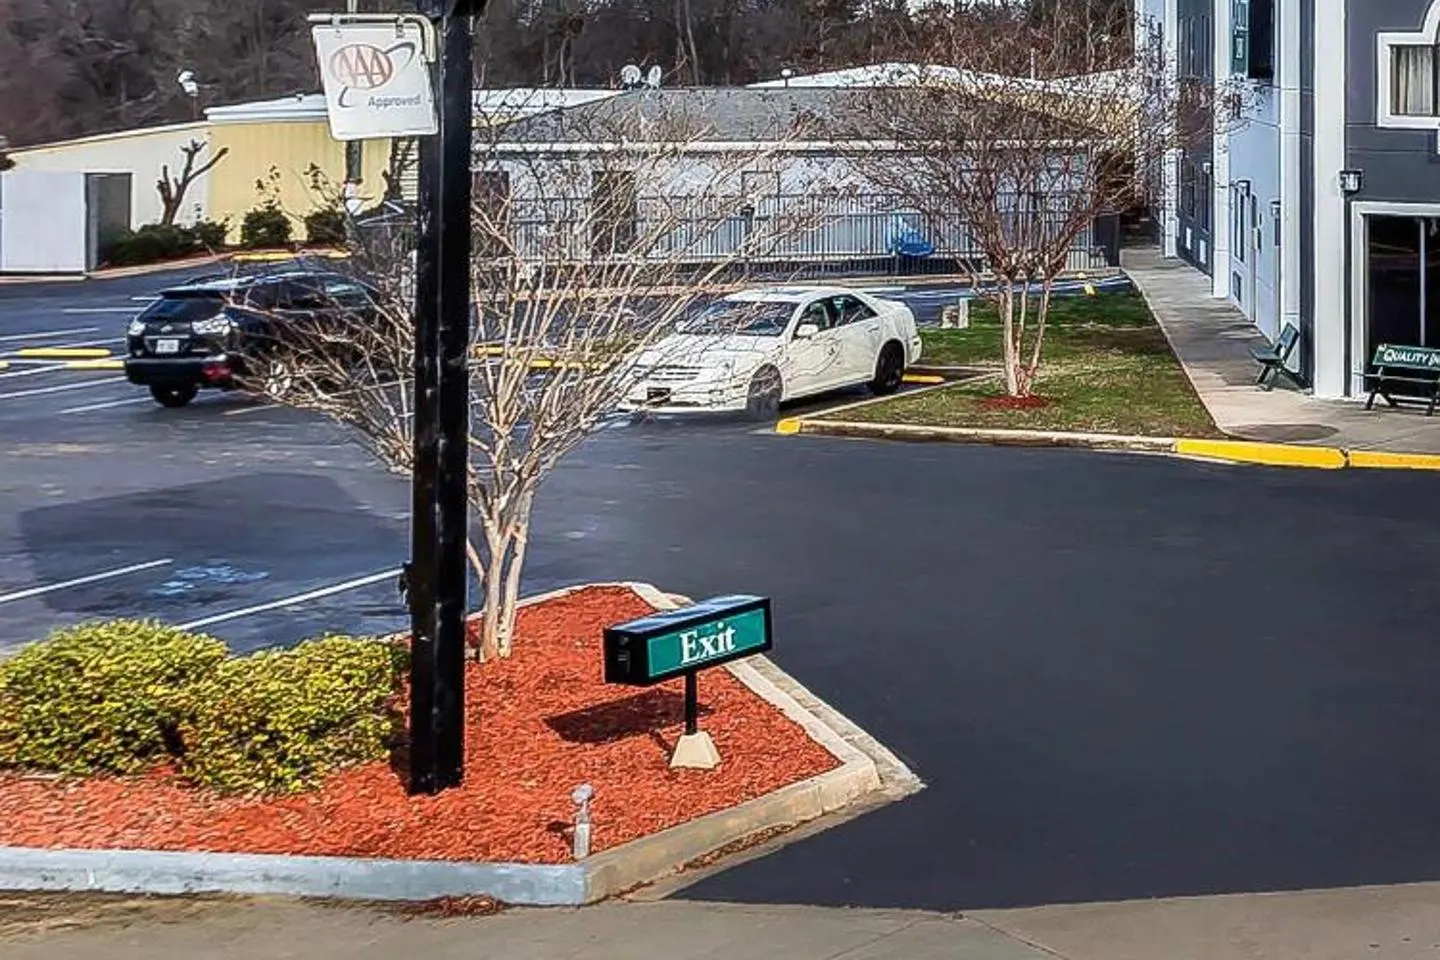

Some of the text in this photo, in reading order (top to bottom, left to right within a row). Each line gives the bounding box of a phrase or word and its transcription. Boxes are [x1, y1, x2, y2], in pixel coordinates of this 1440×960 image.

[334, 45, 391, 89] AAA
[368, 94, 420, 108] Approved
[1384, 349, 1429, 362] QUALITY
[680, 622, 736, 665] Exit
